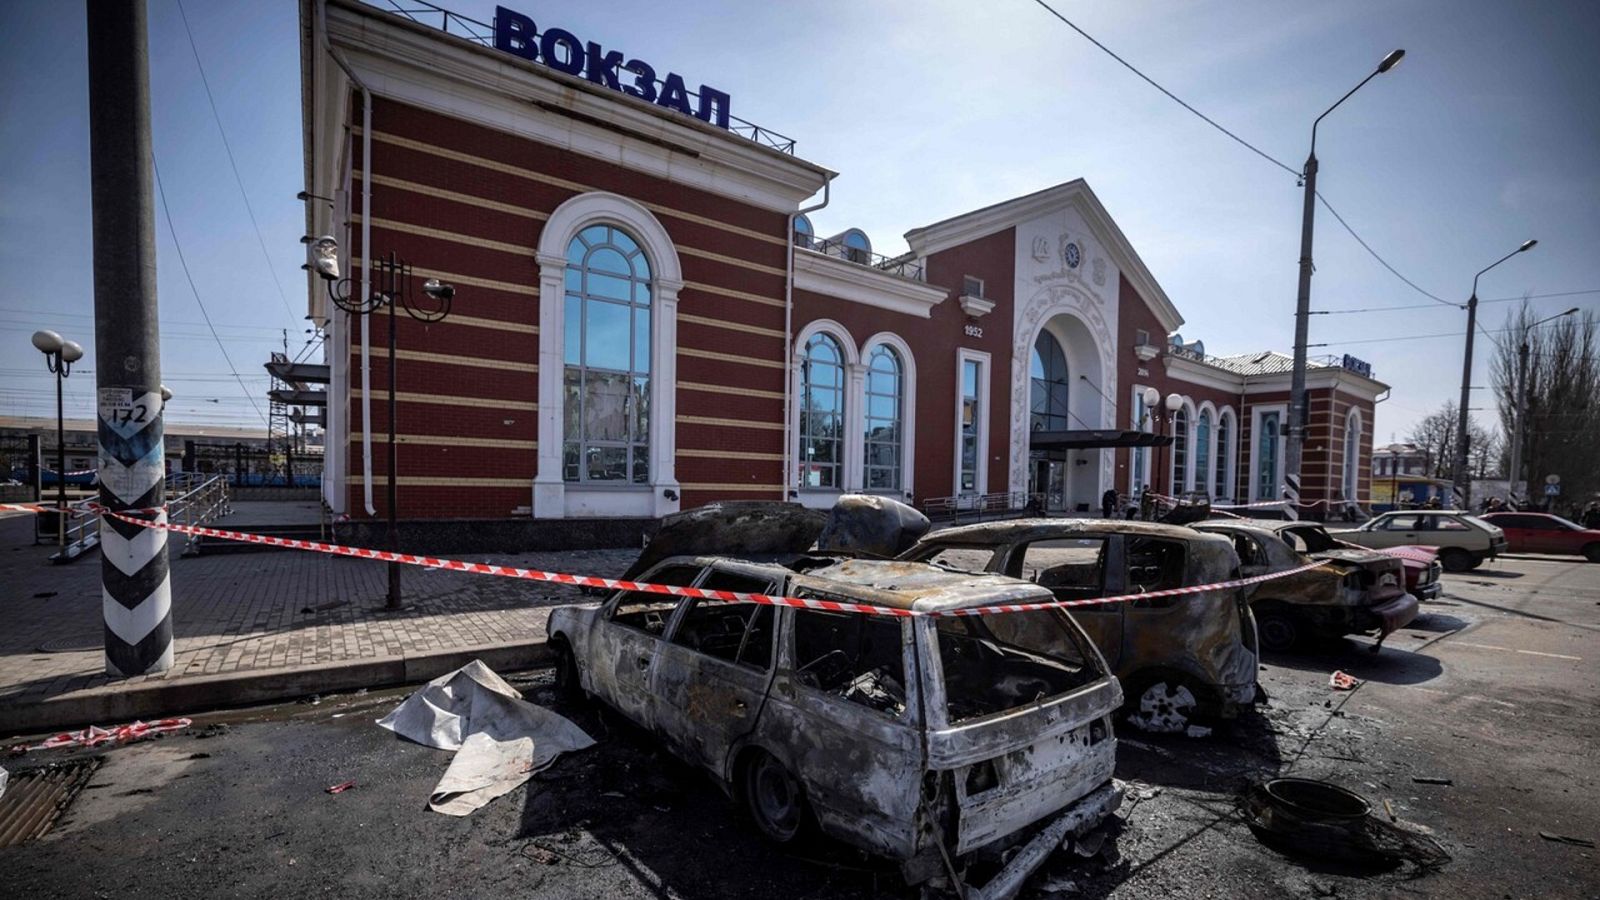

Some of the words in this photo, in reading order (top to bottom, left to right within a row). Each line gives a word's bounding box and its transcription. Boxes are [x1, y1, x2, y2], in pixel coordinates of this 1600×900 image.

[496, 5, 730, 130] ВОКЗАЛ
[964, 324, 983, 338] 1952
[112, 404, 147, 427] 172
